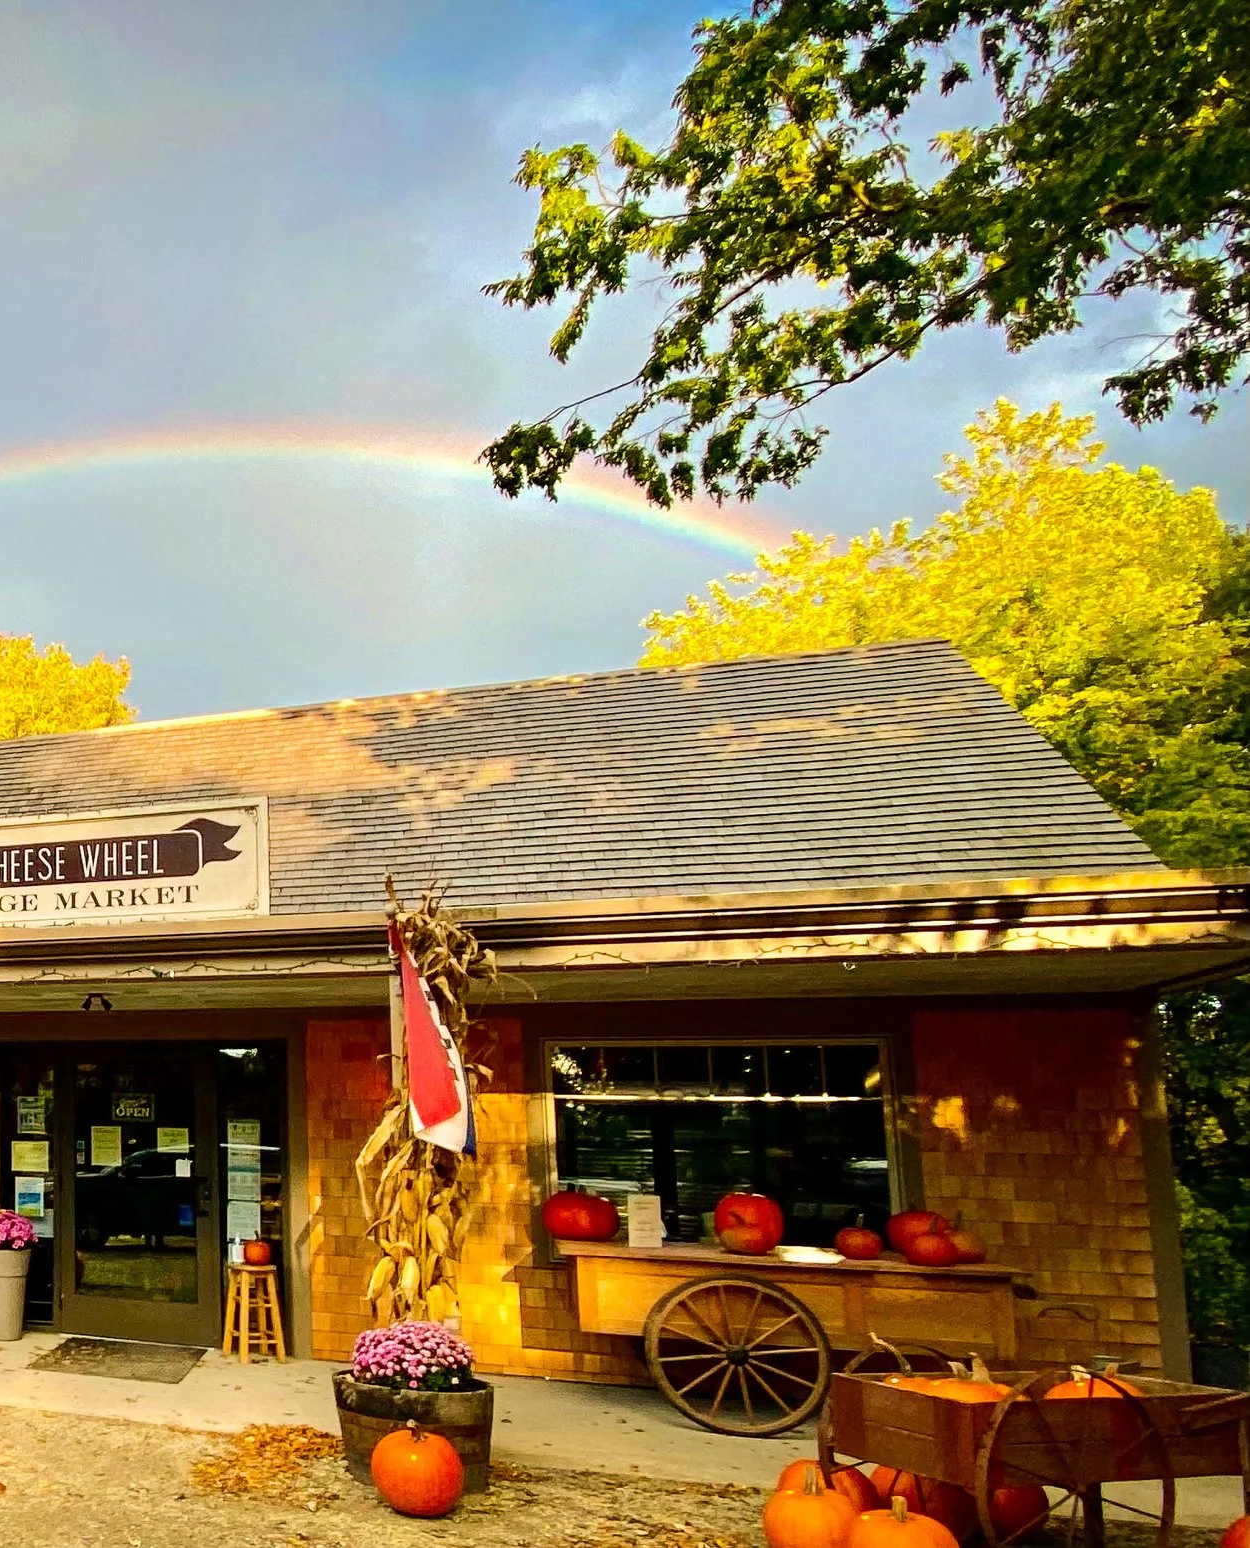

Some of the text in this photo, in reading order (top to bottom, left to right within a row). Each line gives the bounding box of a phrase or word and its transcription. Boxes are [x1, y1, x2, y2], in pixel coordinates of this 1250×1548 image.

[79, 838, 164, 877] WHEEL
[54, 884, 200, 911] MARKET
[116, 1107, 150, 1117] OPEN
